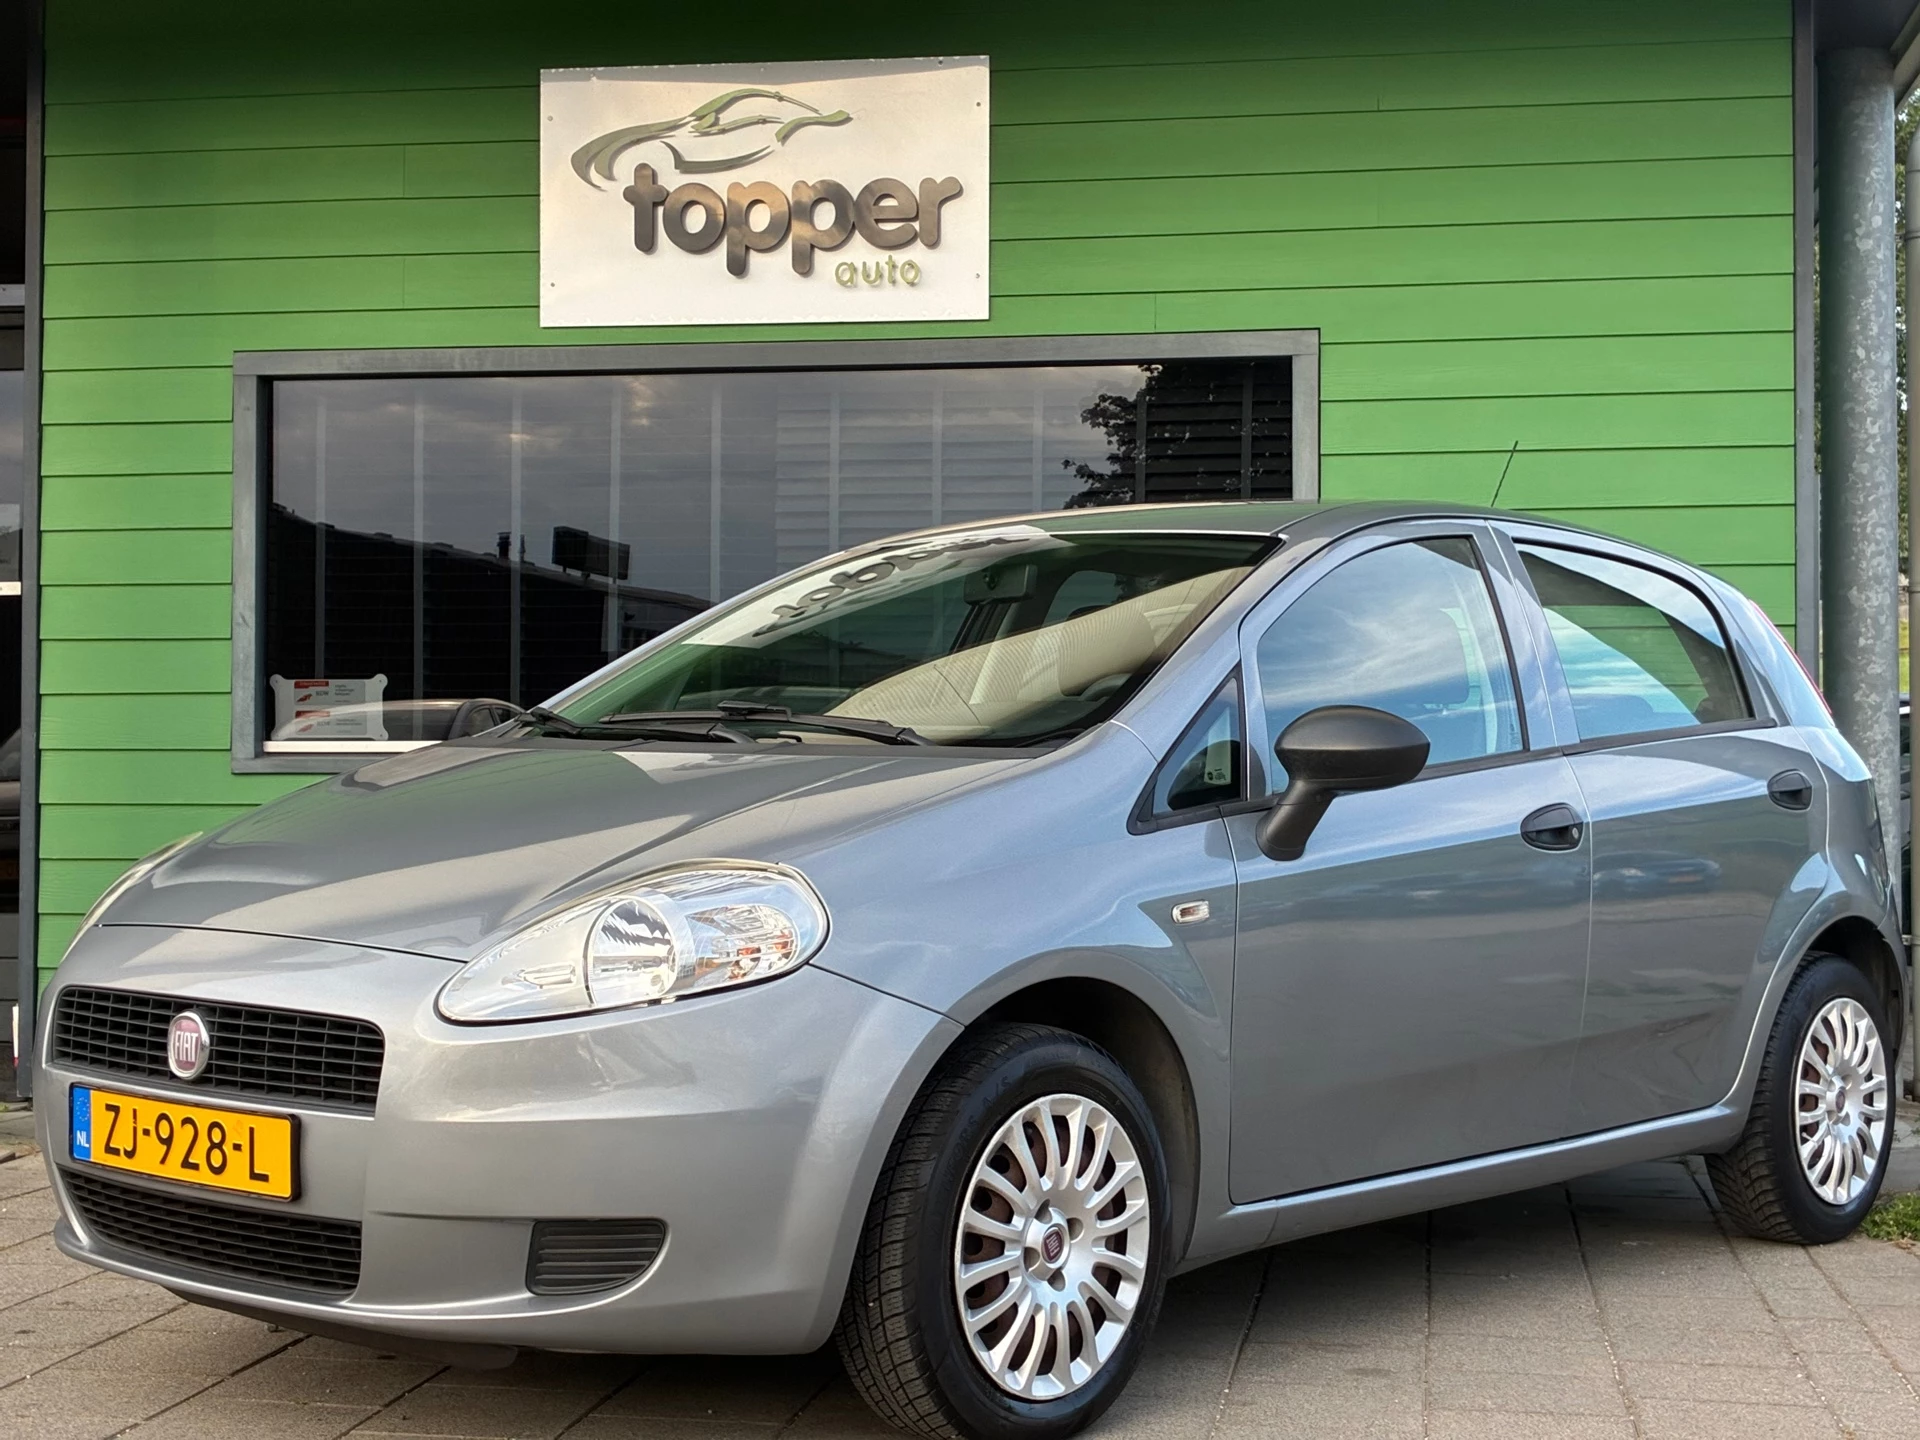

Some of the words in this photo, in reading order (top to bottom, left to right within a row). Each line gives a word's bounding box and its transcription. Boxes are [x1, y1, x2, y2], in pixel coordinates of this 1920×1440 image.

[623, 163, 963, 275] topper
[835, 254, 921, 286] auto
[175, 1031, 199, 1062] FIAT
[76, 1129, 90, 1148] NL
[104, 1103, 270, 1182] ZJ-928-L
